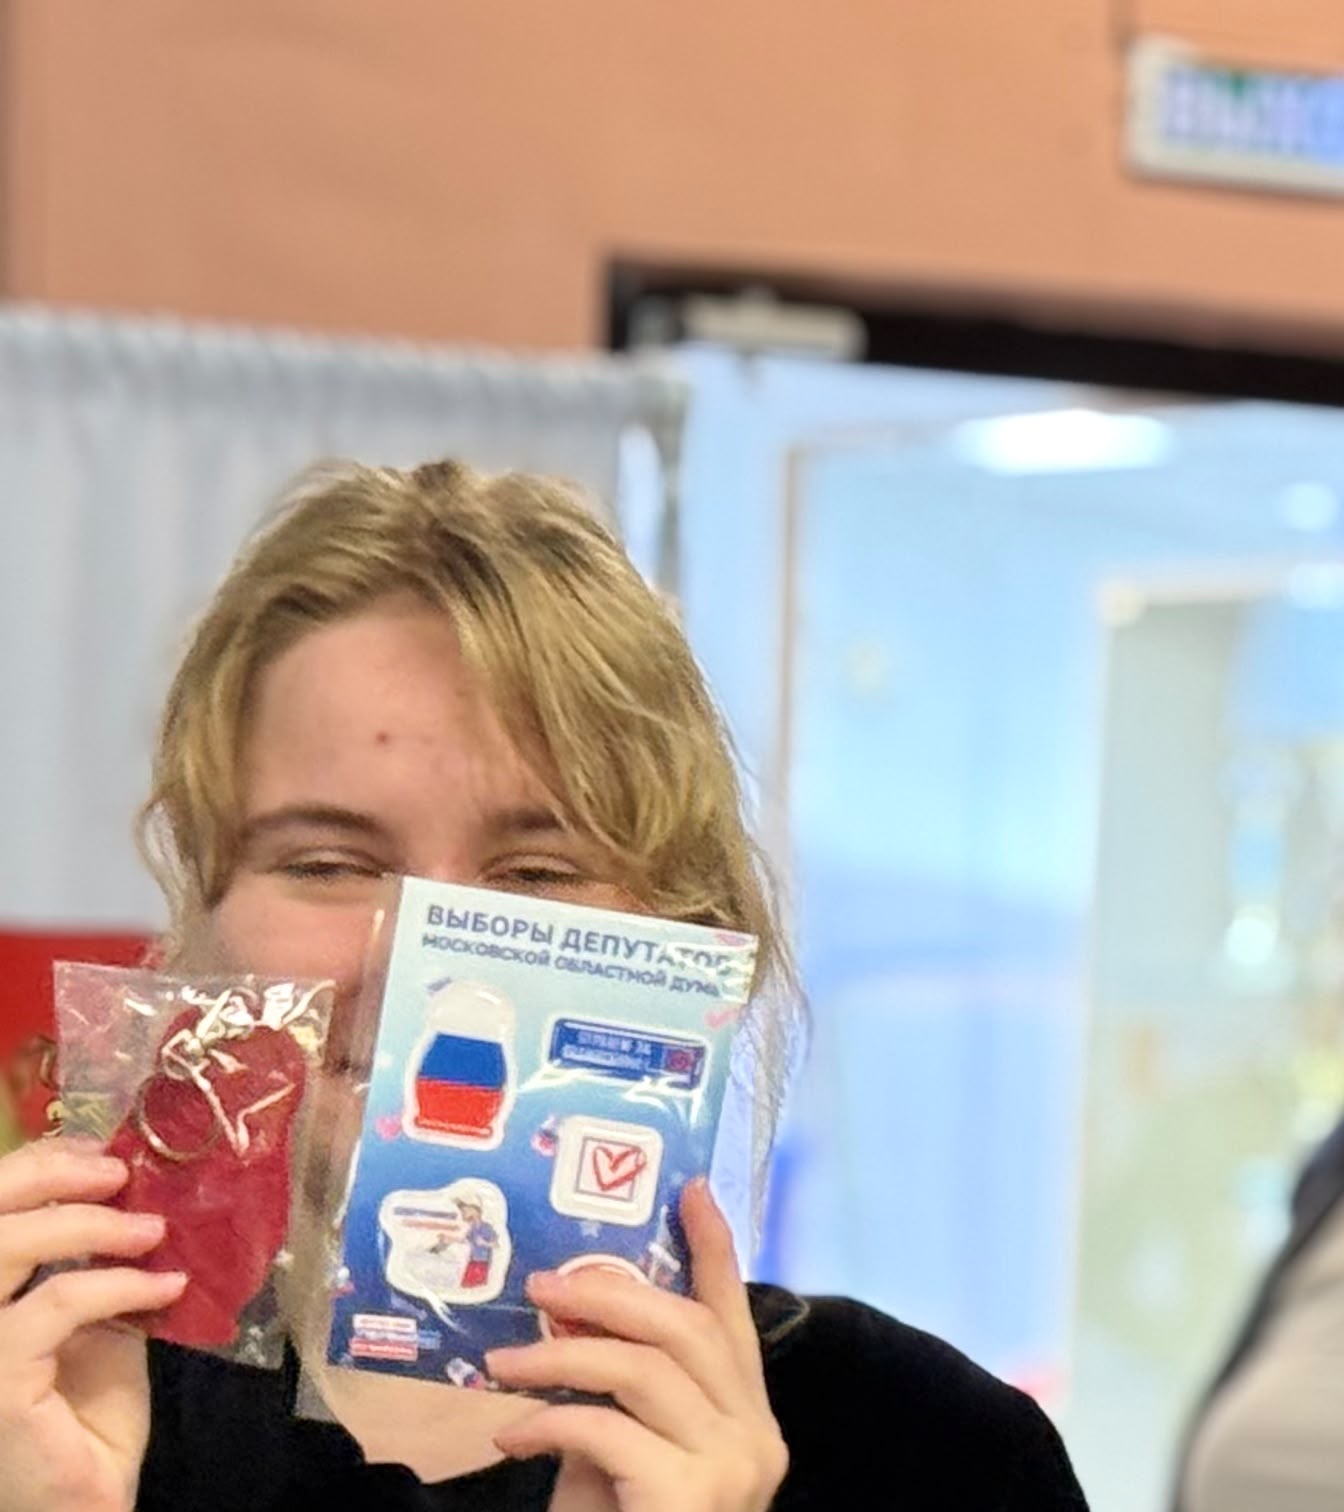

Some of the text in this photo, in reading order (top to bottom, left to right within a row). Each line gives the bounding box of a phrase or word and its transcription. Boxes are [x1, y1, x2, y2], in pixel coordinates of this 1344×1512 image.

[427, 904, 555, 944] ВЫБОРЫ
[422, 933, 550, 967] МОСКОВСКОЙ
[555, 956, 666, 987] ОБЛАСТНОЙ
